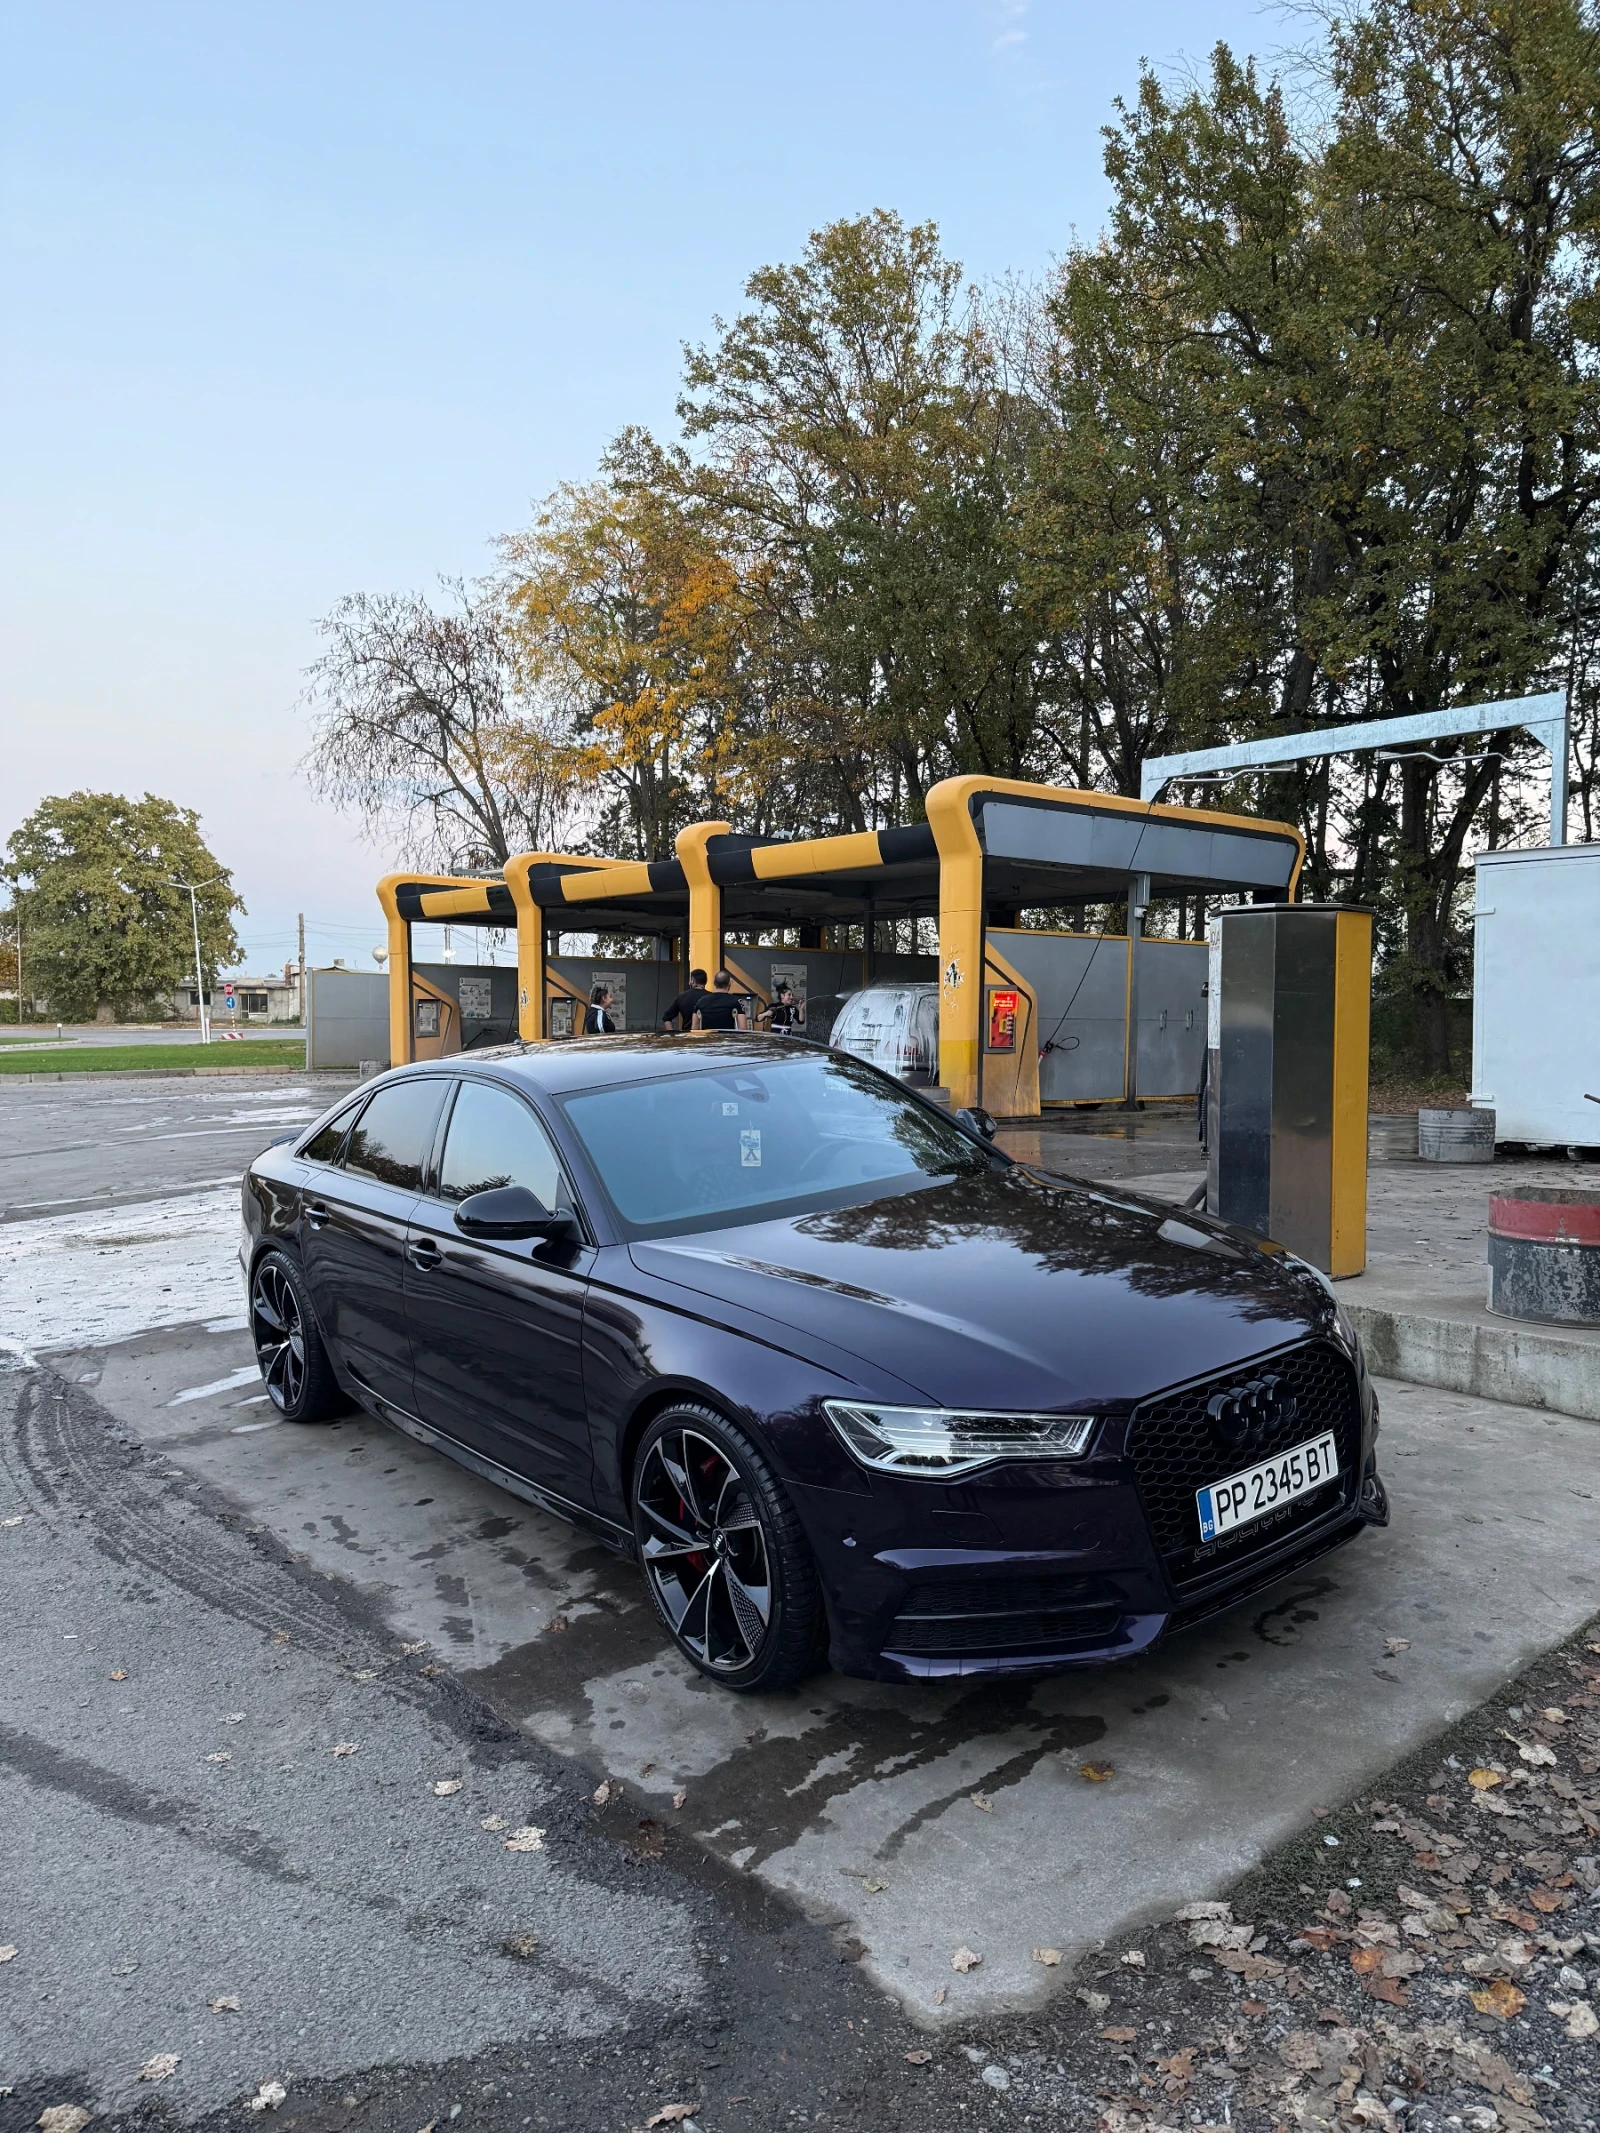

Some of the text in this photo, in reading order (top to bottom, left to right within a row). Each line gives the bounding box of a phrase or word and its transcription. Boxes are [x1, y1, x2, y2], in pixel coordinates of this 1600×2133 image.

[1215, 1439, 1331, 1527] PP 2345 BT
[1202, 1519, 1214, 1533] BG
